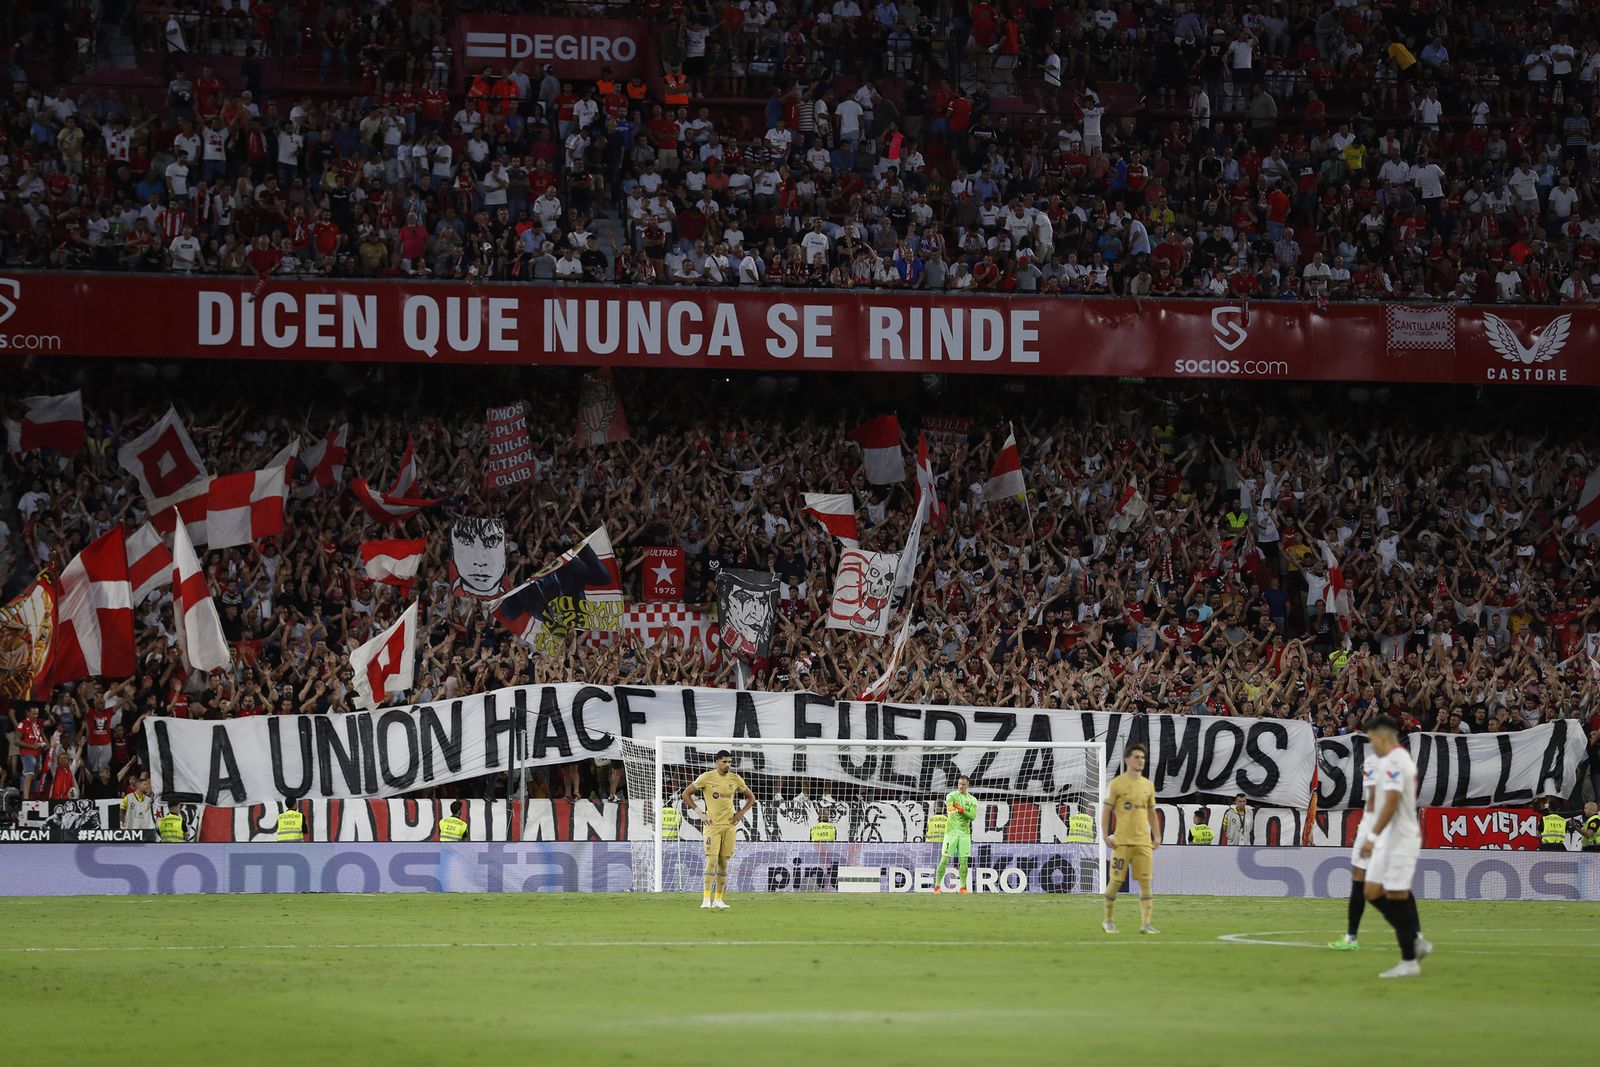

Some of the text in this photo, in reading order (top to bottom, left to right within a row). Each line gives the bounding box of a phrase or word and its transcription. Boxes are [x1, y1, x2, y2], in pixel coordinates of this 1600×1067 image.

[510, 33, 637, 62] DEGIRO
[198, 290, 1041, 362] DICEN QUE NUNCA SE RINDE
[1394, 319, 1447, 332] CANTILLANA
[1486, 367, 1567, 381] CASTORE
[495, 467, 531, 486] CLUB
[649, 549, 678, 557] ULTRAS
[653, 586, 677, 595] 1975
[153, 719, 247, 806] LA
[267, 700, 463, 798] UNIÓN
[681, 688, 766, 772] LA
[1081, 711, 1289, 798] VAMOS
[1441, 810, 1537, 843] LA VIEJA
[0, 829, 50, 842] ANCAM
[77, 829, 144, 842] #FANCAM
[1111, 857, 1124, 870] 30
[888, 866, 1028, 894] DEGIRO
